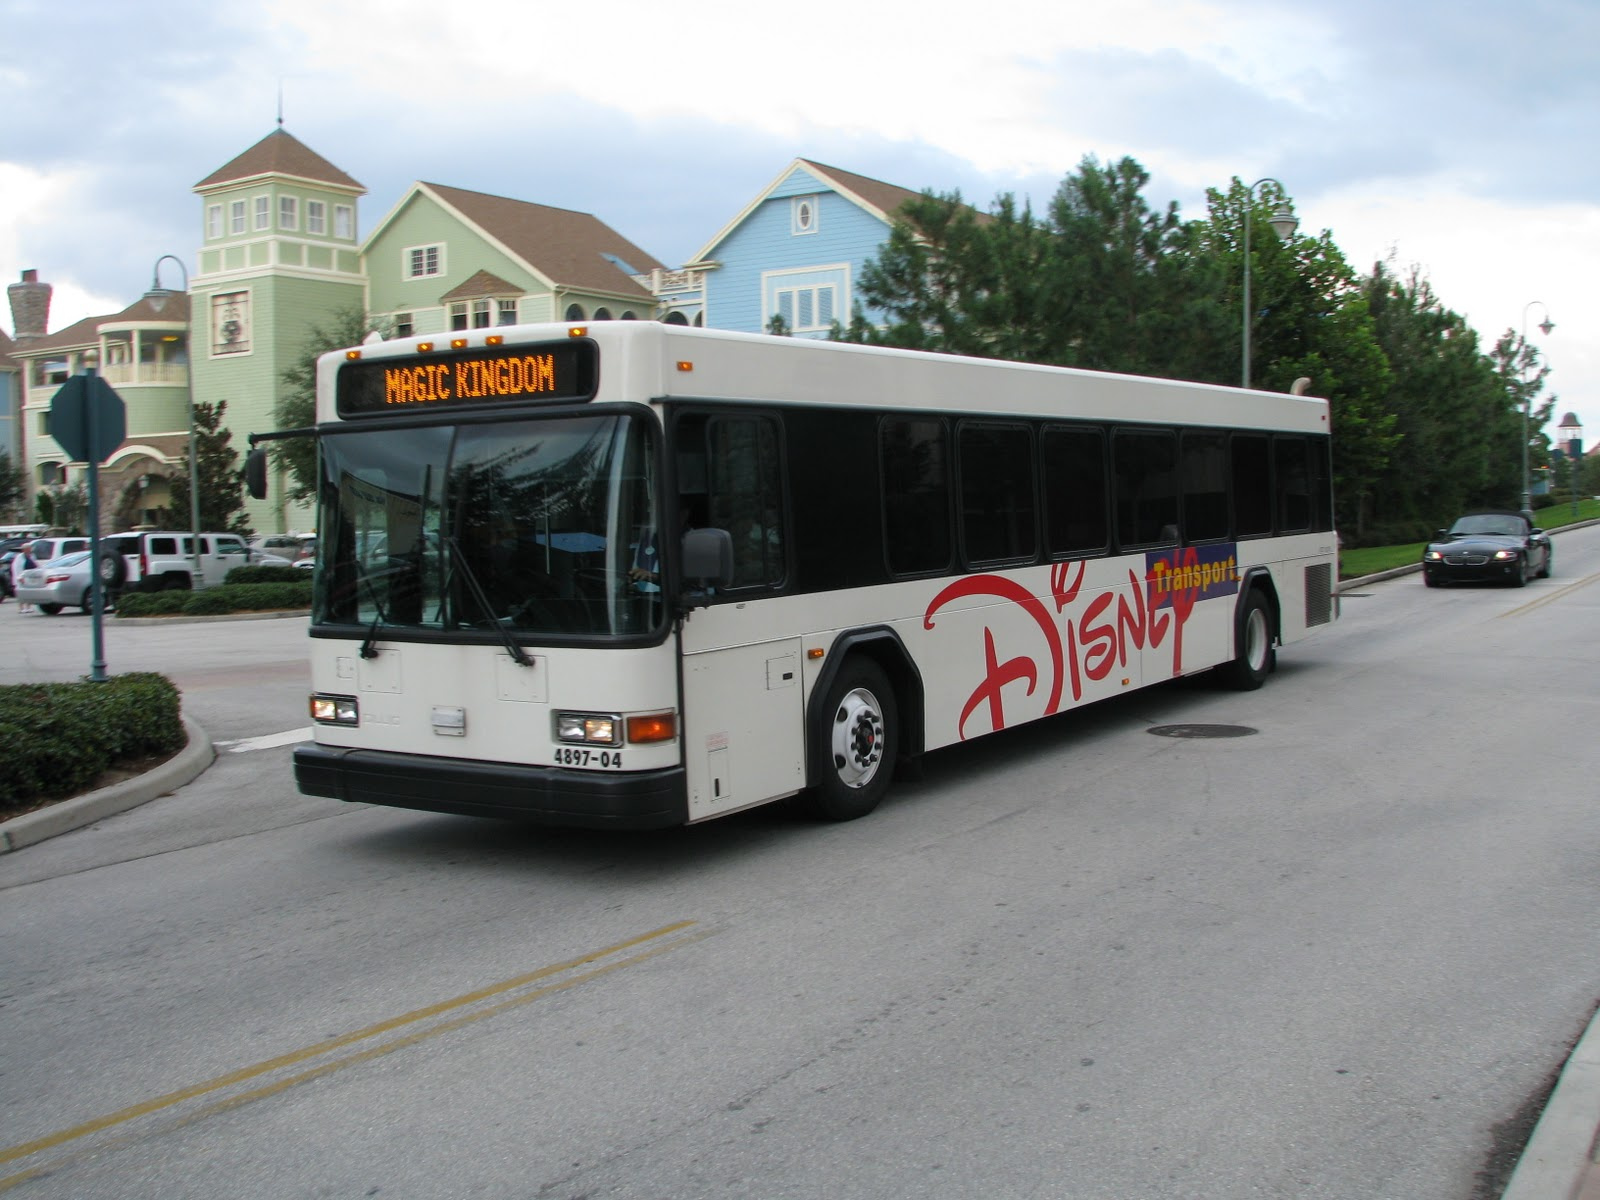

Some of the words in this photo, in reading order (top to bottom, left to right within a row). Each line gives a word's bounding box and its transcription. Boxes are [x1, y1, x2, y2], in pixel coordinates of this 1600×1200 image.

[385, 364, 451, 404] MAGIC
[455, 354, 555, 398] KINGDOM
[1153, 555, 1235, 593] Transport
[554, 748, 622, 769] 4897-04
